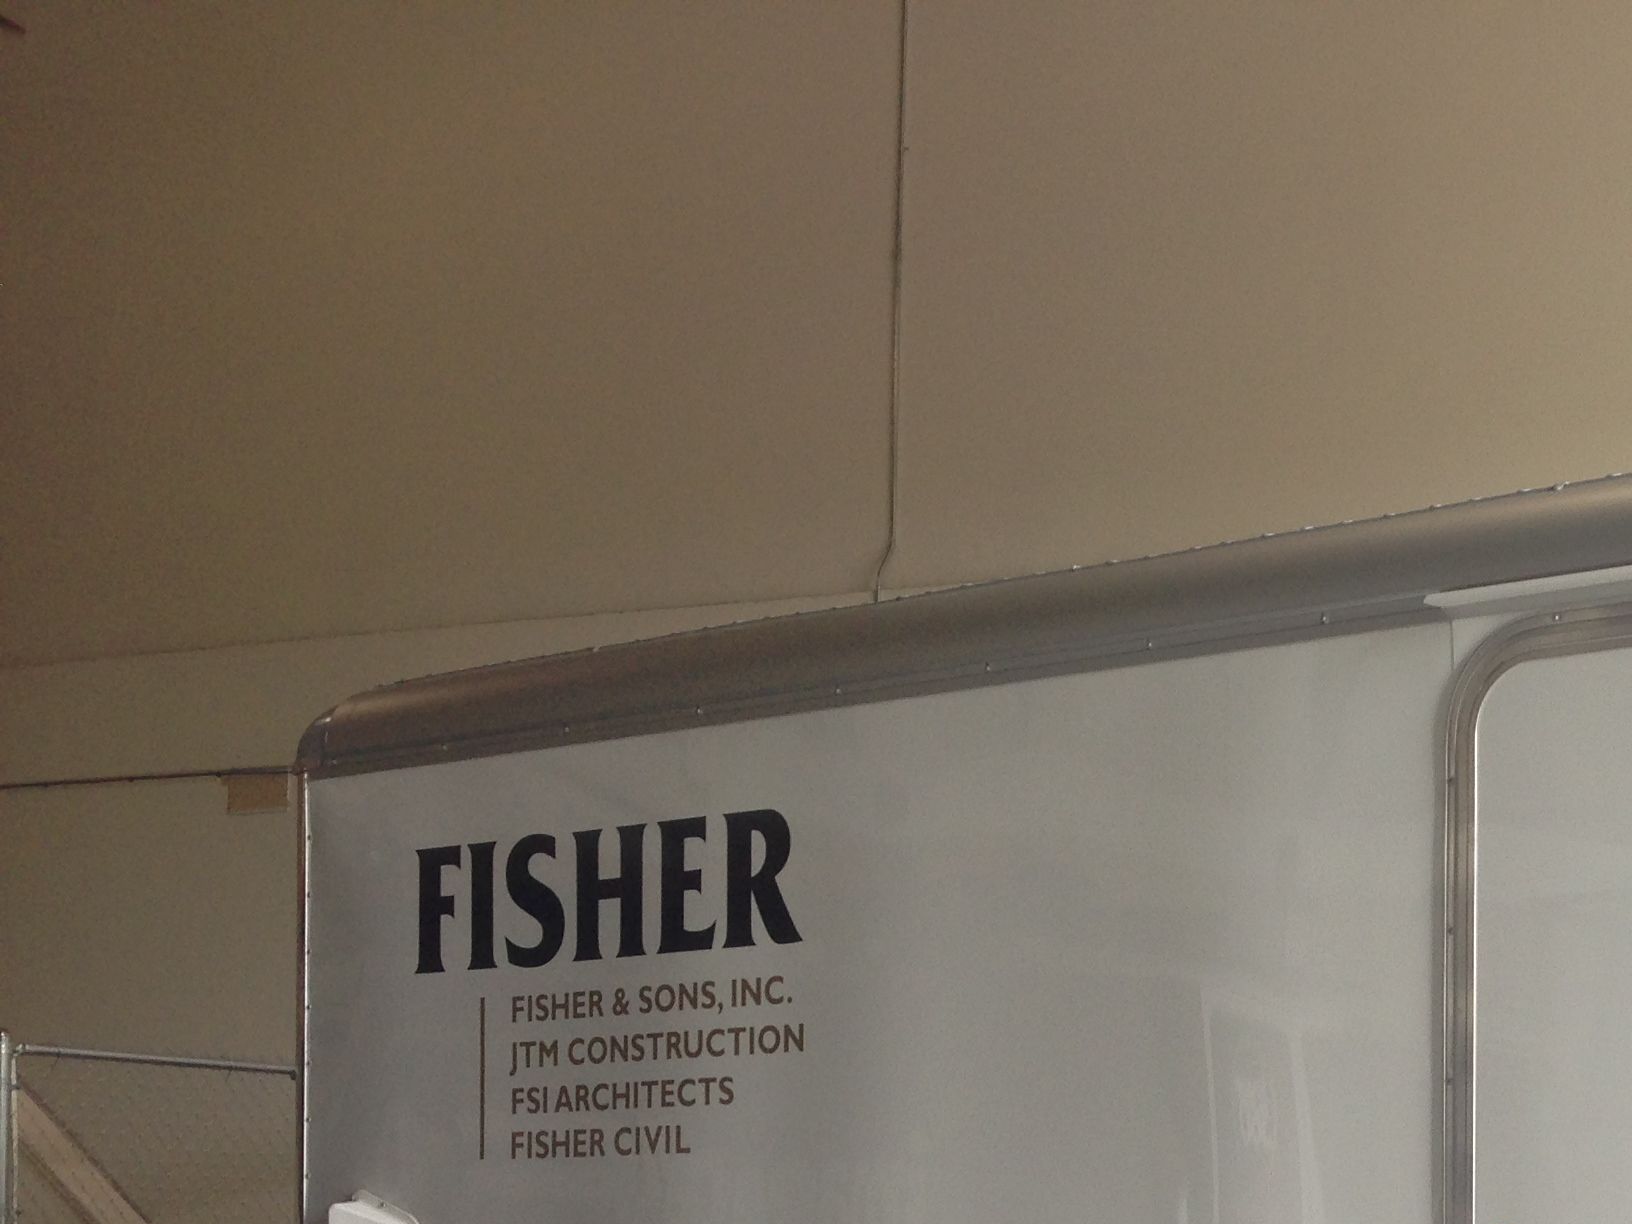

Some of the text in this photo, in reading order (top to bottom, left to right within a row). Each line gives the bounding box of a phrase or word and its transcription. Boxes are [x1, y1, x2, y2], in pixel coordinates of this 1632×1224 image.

[414, 808, 804, 975] FISHER
[511, 975, 794, 1024] FISHER & SONS, INC.
[509, 1023, 806, 1077] JTM CONSTRUCTION
[511, 1076, 736, 1116] FSI ARCHITECTS
[511, 1124, 692, 1161] FISHER CIVIL
